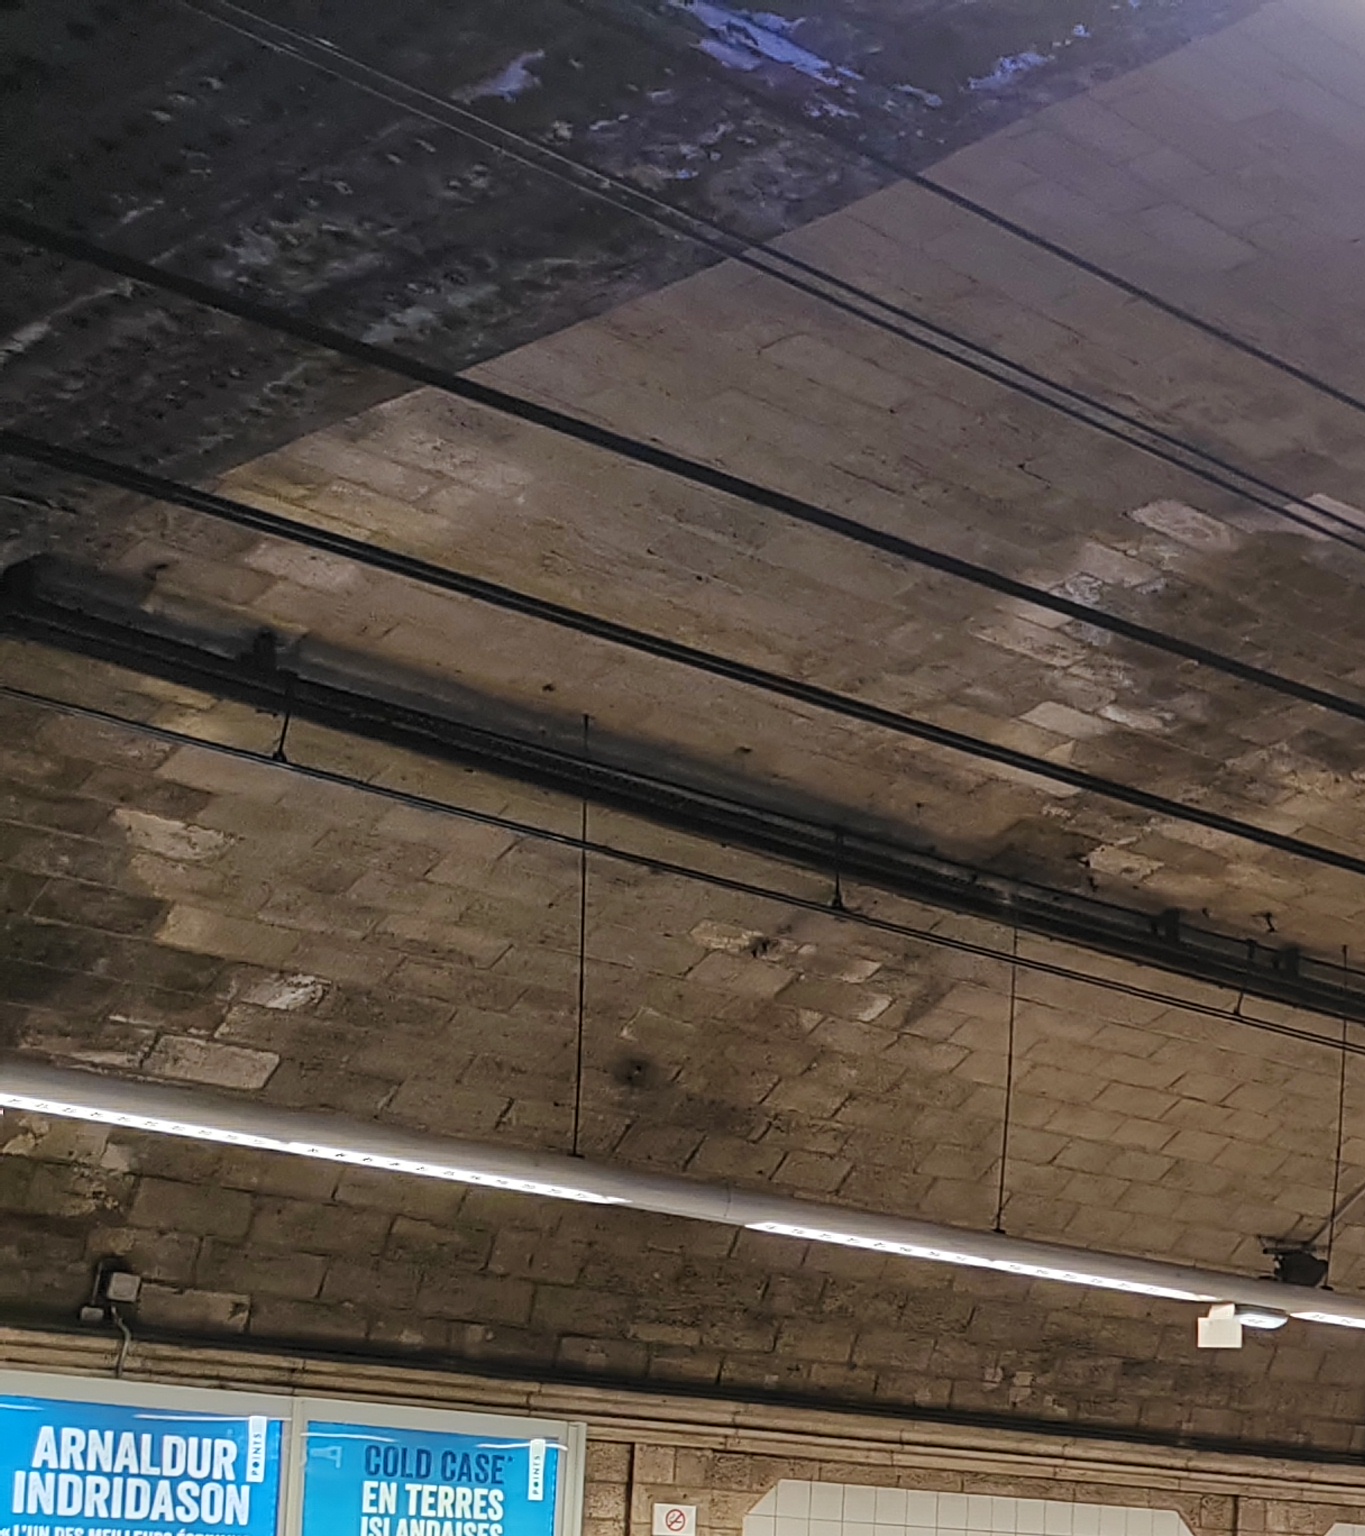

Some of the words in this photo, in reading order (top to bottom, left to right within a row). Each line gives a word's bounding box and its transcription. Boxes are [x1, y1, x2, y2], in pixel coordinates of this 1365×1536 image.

[31, 1425, 238, 1482] ARNALDUR
[365, 1445, 432, 1480] COLD
[12, 1470, 250, 1526] INDRIDASON
[362, 1480, 397, 1515] EN
[405, 1483, 504, 1522] TERRES
